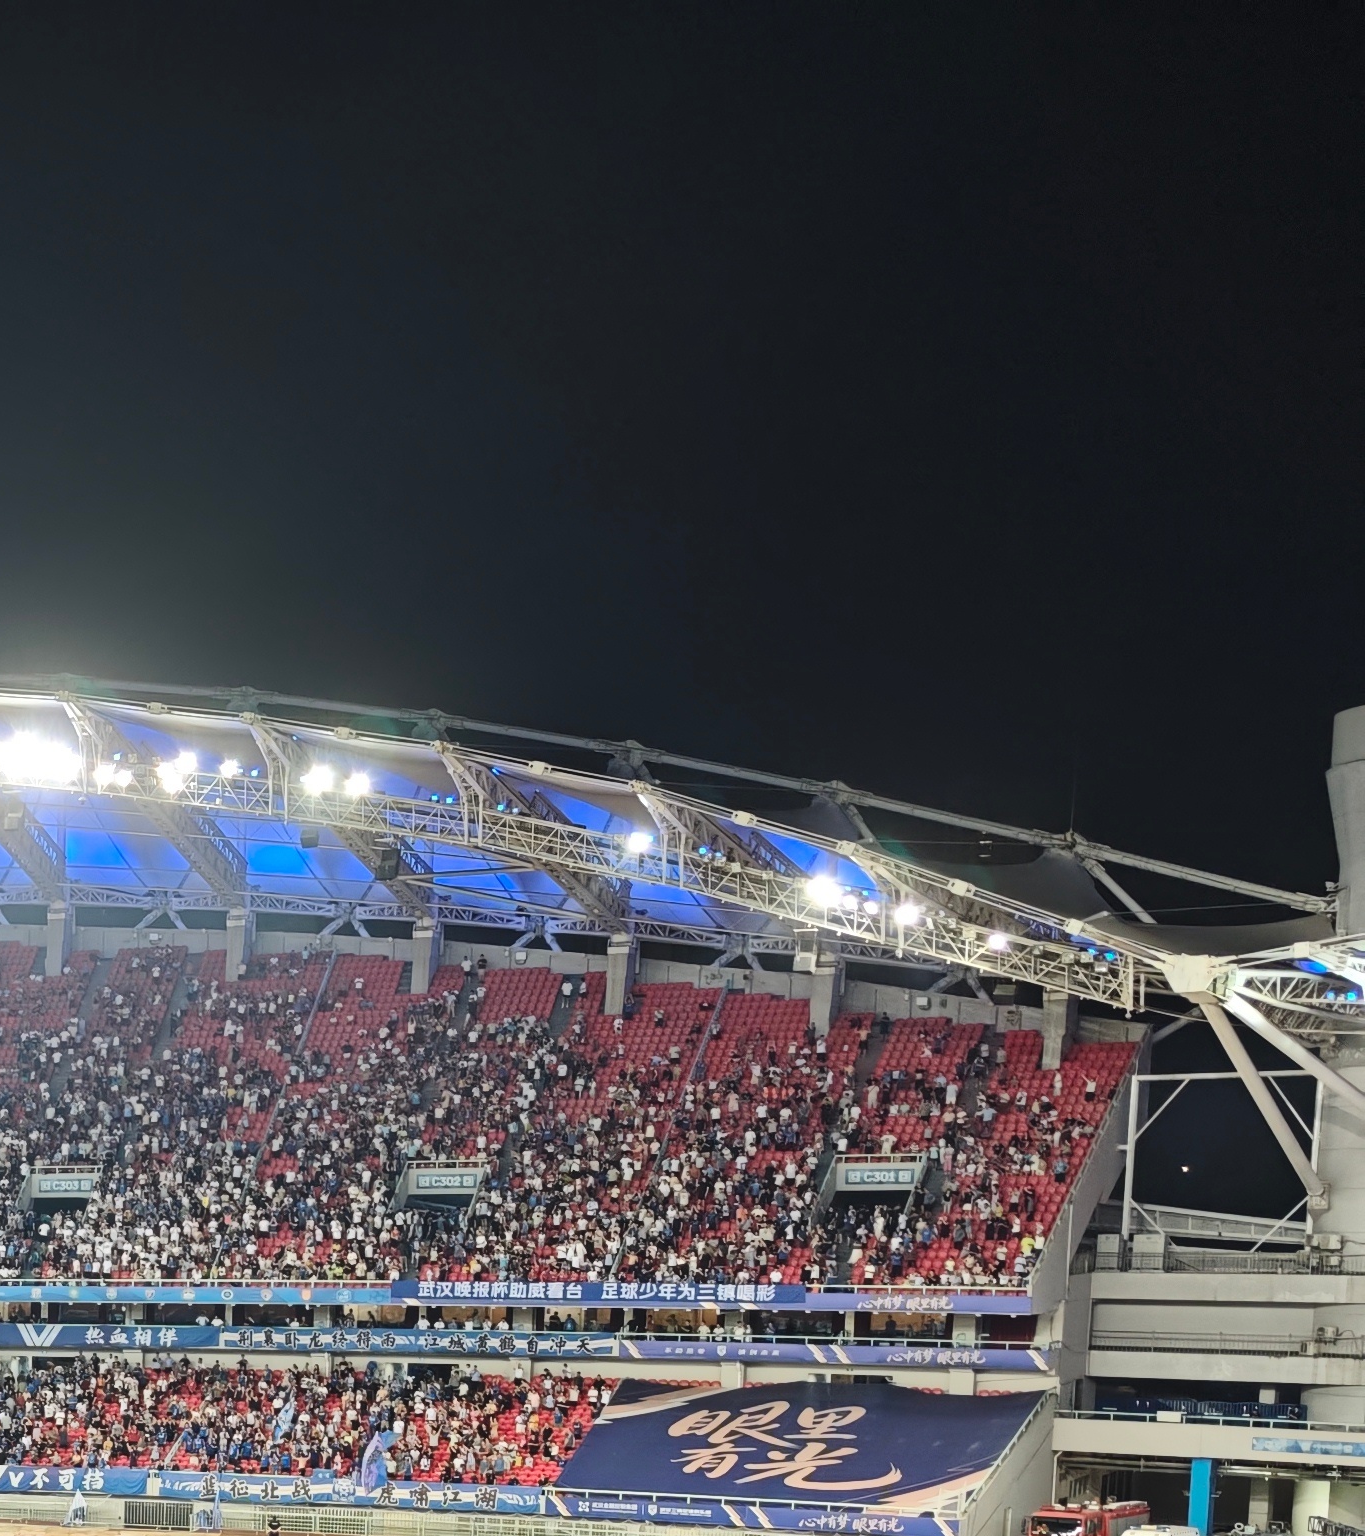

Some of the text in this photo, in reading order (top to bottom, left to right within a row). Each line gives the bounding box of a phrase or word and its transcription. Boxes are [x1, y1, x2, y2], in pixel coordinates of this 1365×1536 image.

[52, 1180, 79, 1191] C303
[431, 1176, 461, 1187] C302
[863, 1171, 896, 1183] C301
[417, 1281, 776, 1302] 武汉晚报杯助威看台 足球少年为三镇喝彩
[857, 1294, 903, 1311] 心中有梦
[84, 1326, 180, 1347] 热血相伴
[423, 1333, 595, 1356] 江城黄鹤自冲天
[886, 1346, 934, 1365] 心中有梦
[668, 1400, 868, 1450] 眼里
[670, 1443, 903, 1491] 有光
[374, 1482, 500, 1510] 虎啸江湖
[798, 1515, 904, 1534] 心中有梦 眼里有光
